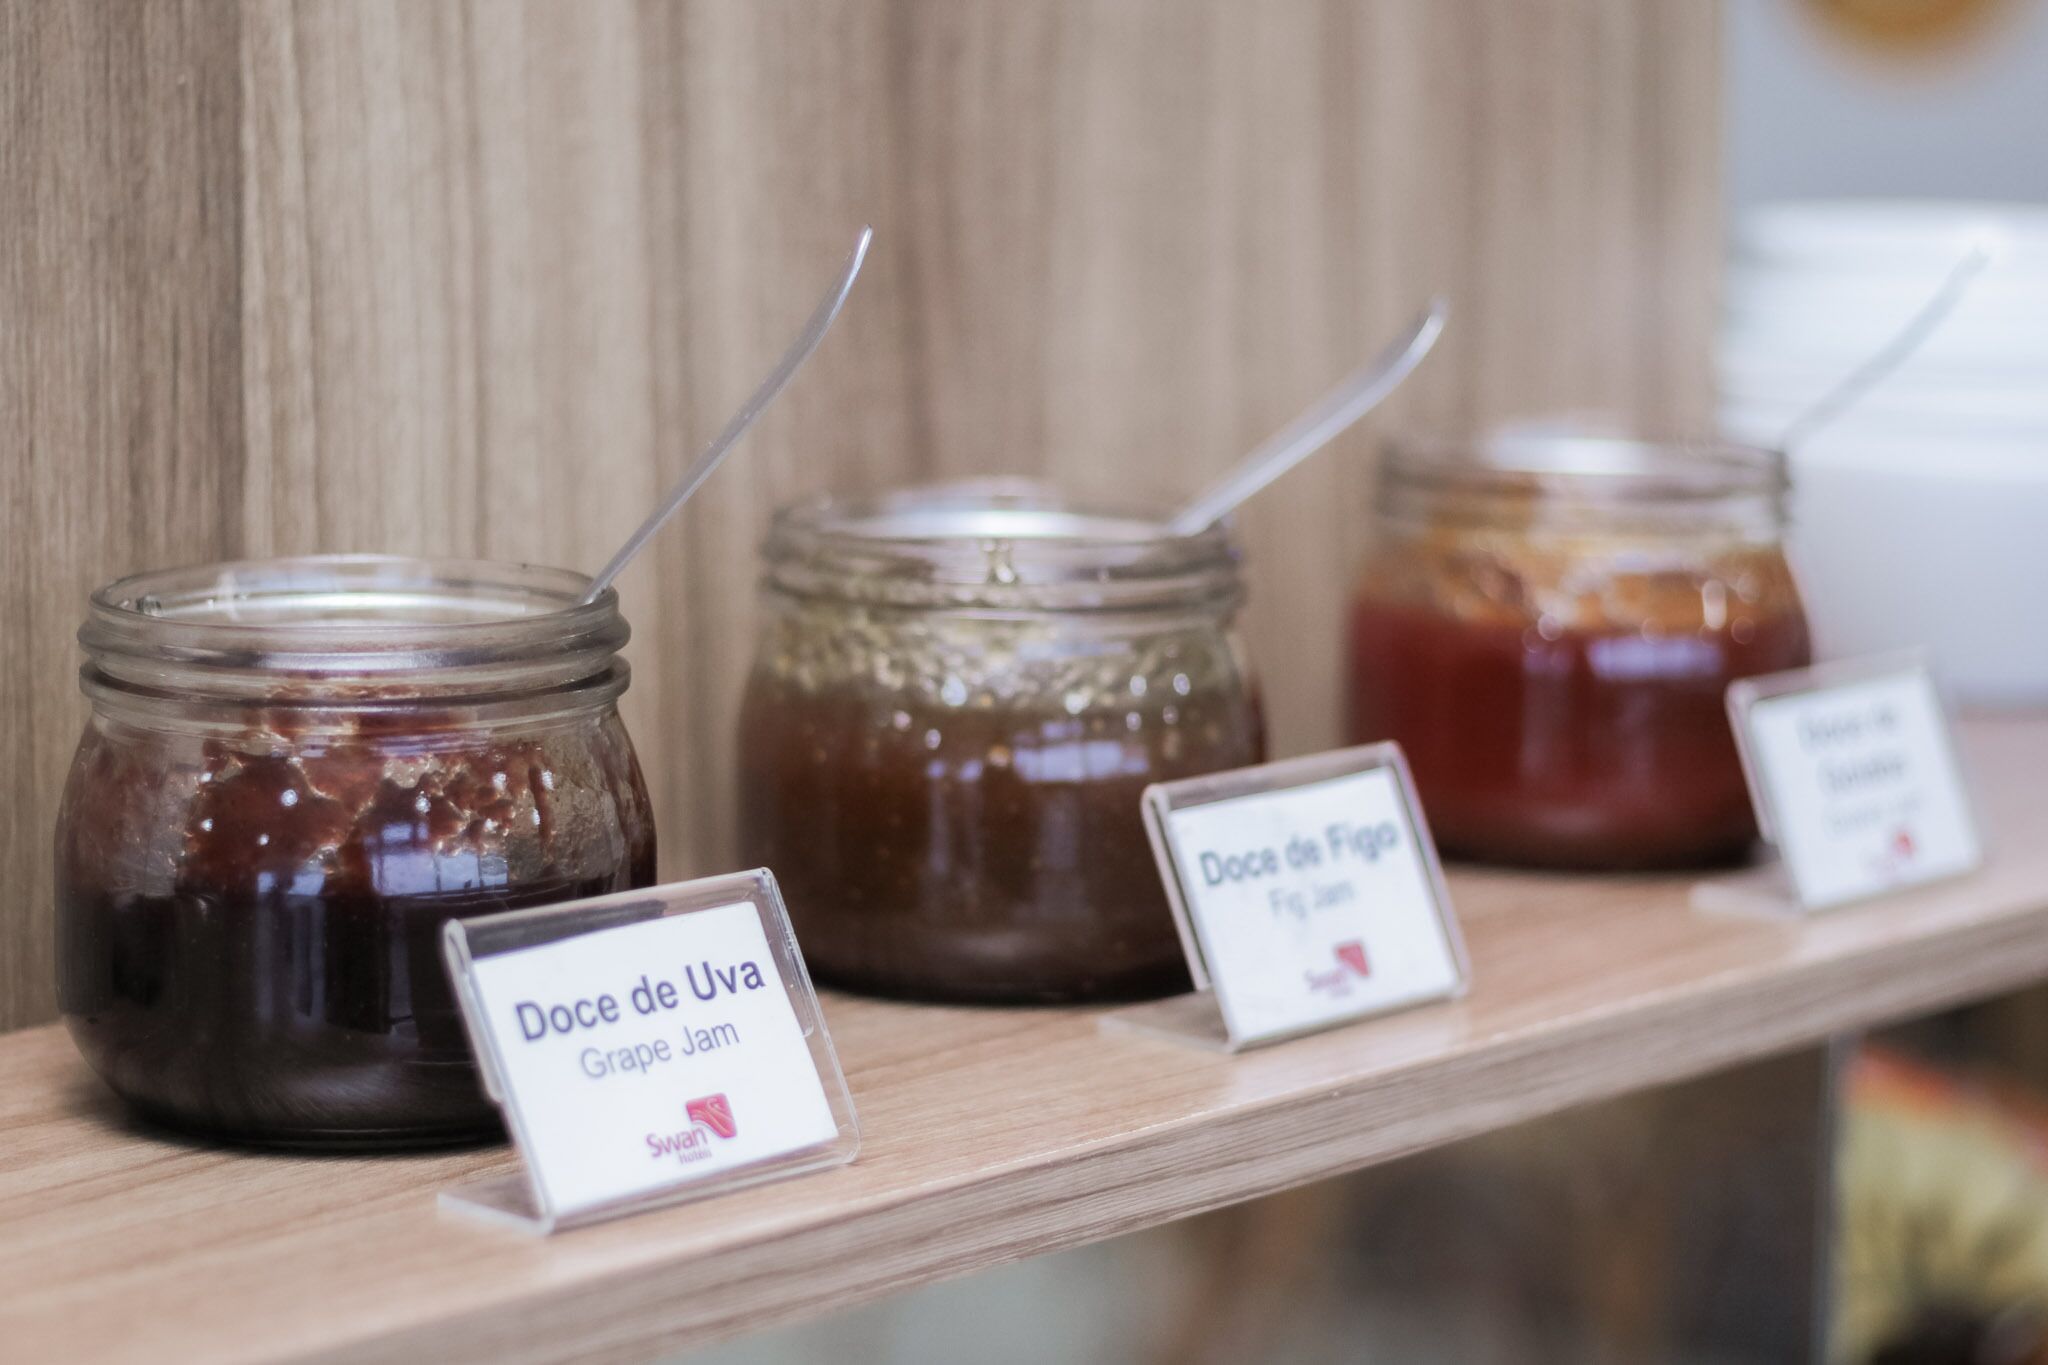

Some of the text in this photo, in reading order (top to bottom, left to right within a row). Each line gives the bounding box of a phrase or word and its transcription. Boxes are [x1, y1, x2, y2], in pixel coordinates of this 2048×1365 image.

[514, 959, 766, 1042] Doce de Uva
[579, 1020, 741, 1080] Grape Jam
[645, 1126, 709, 1158] Swan
